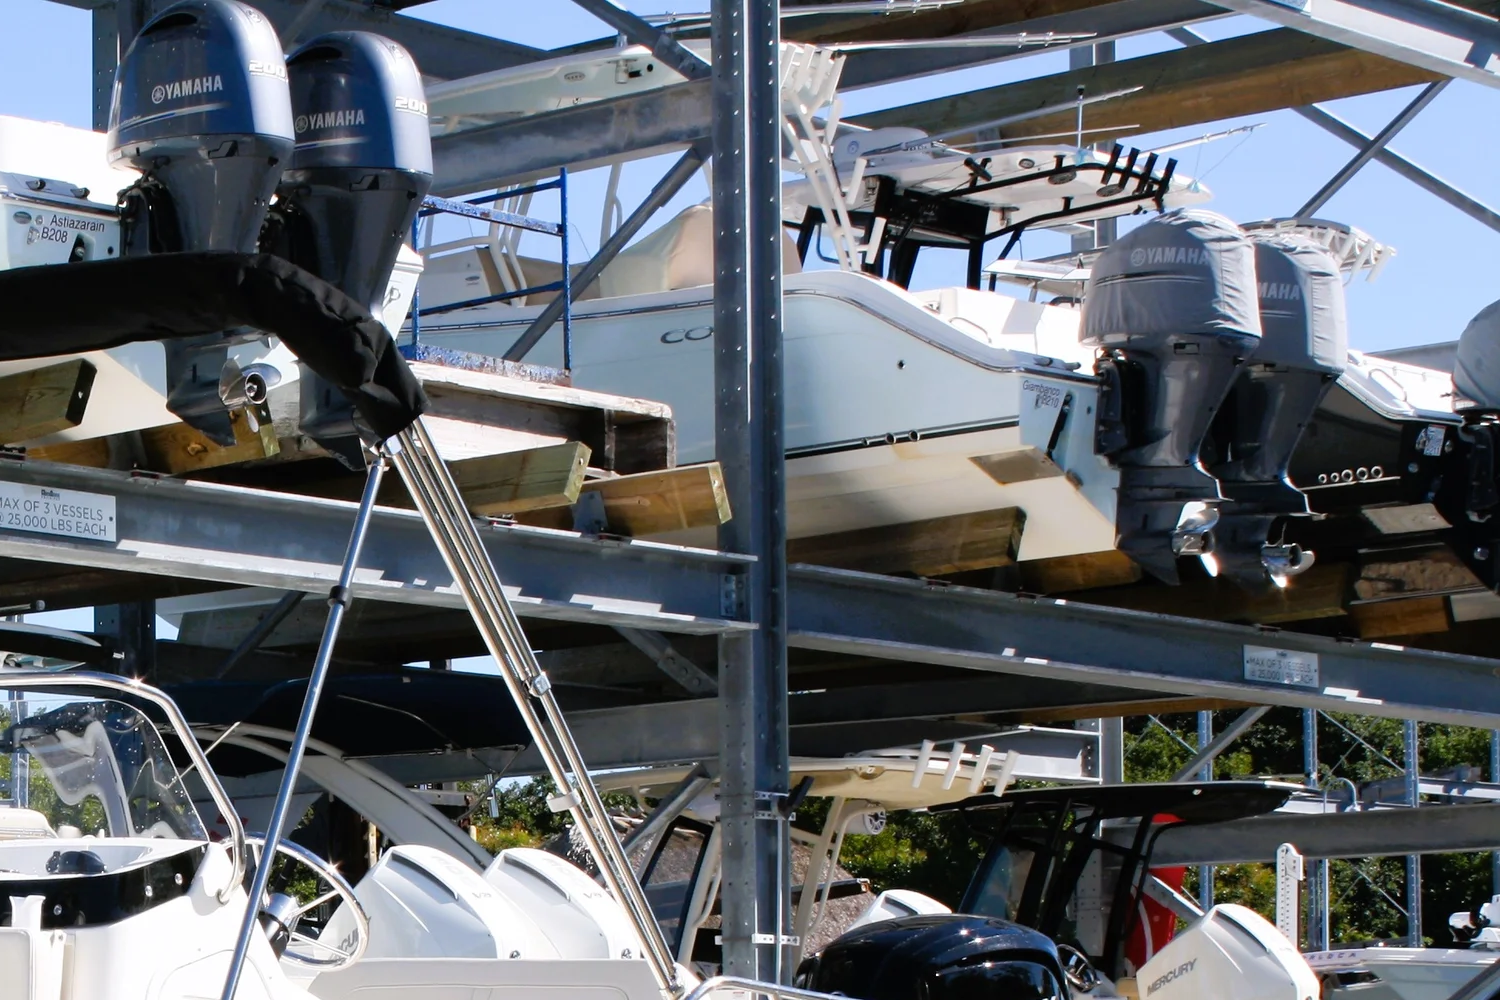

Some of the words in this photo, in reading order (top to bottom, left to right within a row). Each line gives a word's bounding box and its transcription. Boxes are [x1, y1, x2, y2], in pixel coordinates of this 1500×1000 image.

[165, 74, 224, 100] YAMAHA
[395, 96, 428, 115] 200
[309, 109, 365, 130] YAMAHA
[50, 214, 105, 233] Astiazarain
[41, 226, 68, 244] B208
[1146, 247, 1211, 266] YAMAHA
[23, 500, 40, 513] OF
[43, 502, 51, 515] 3
[53, 504, 104, 522] VESSELS
[7, 513, 48, 529] 25,000
[51, 518, 73, 533] LBS
[75, 521, 108, 537] EACH
[1146, 957, 1198, 998] MERCURY
